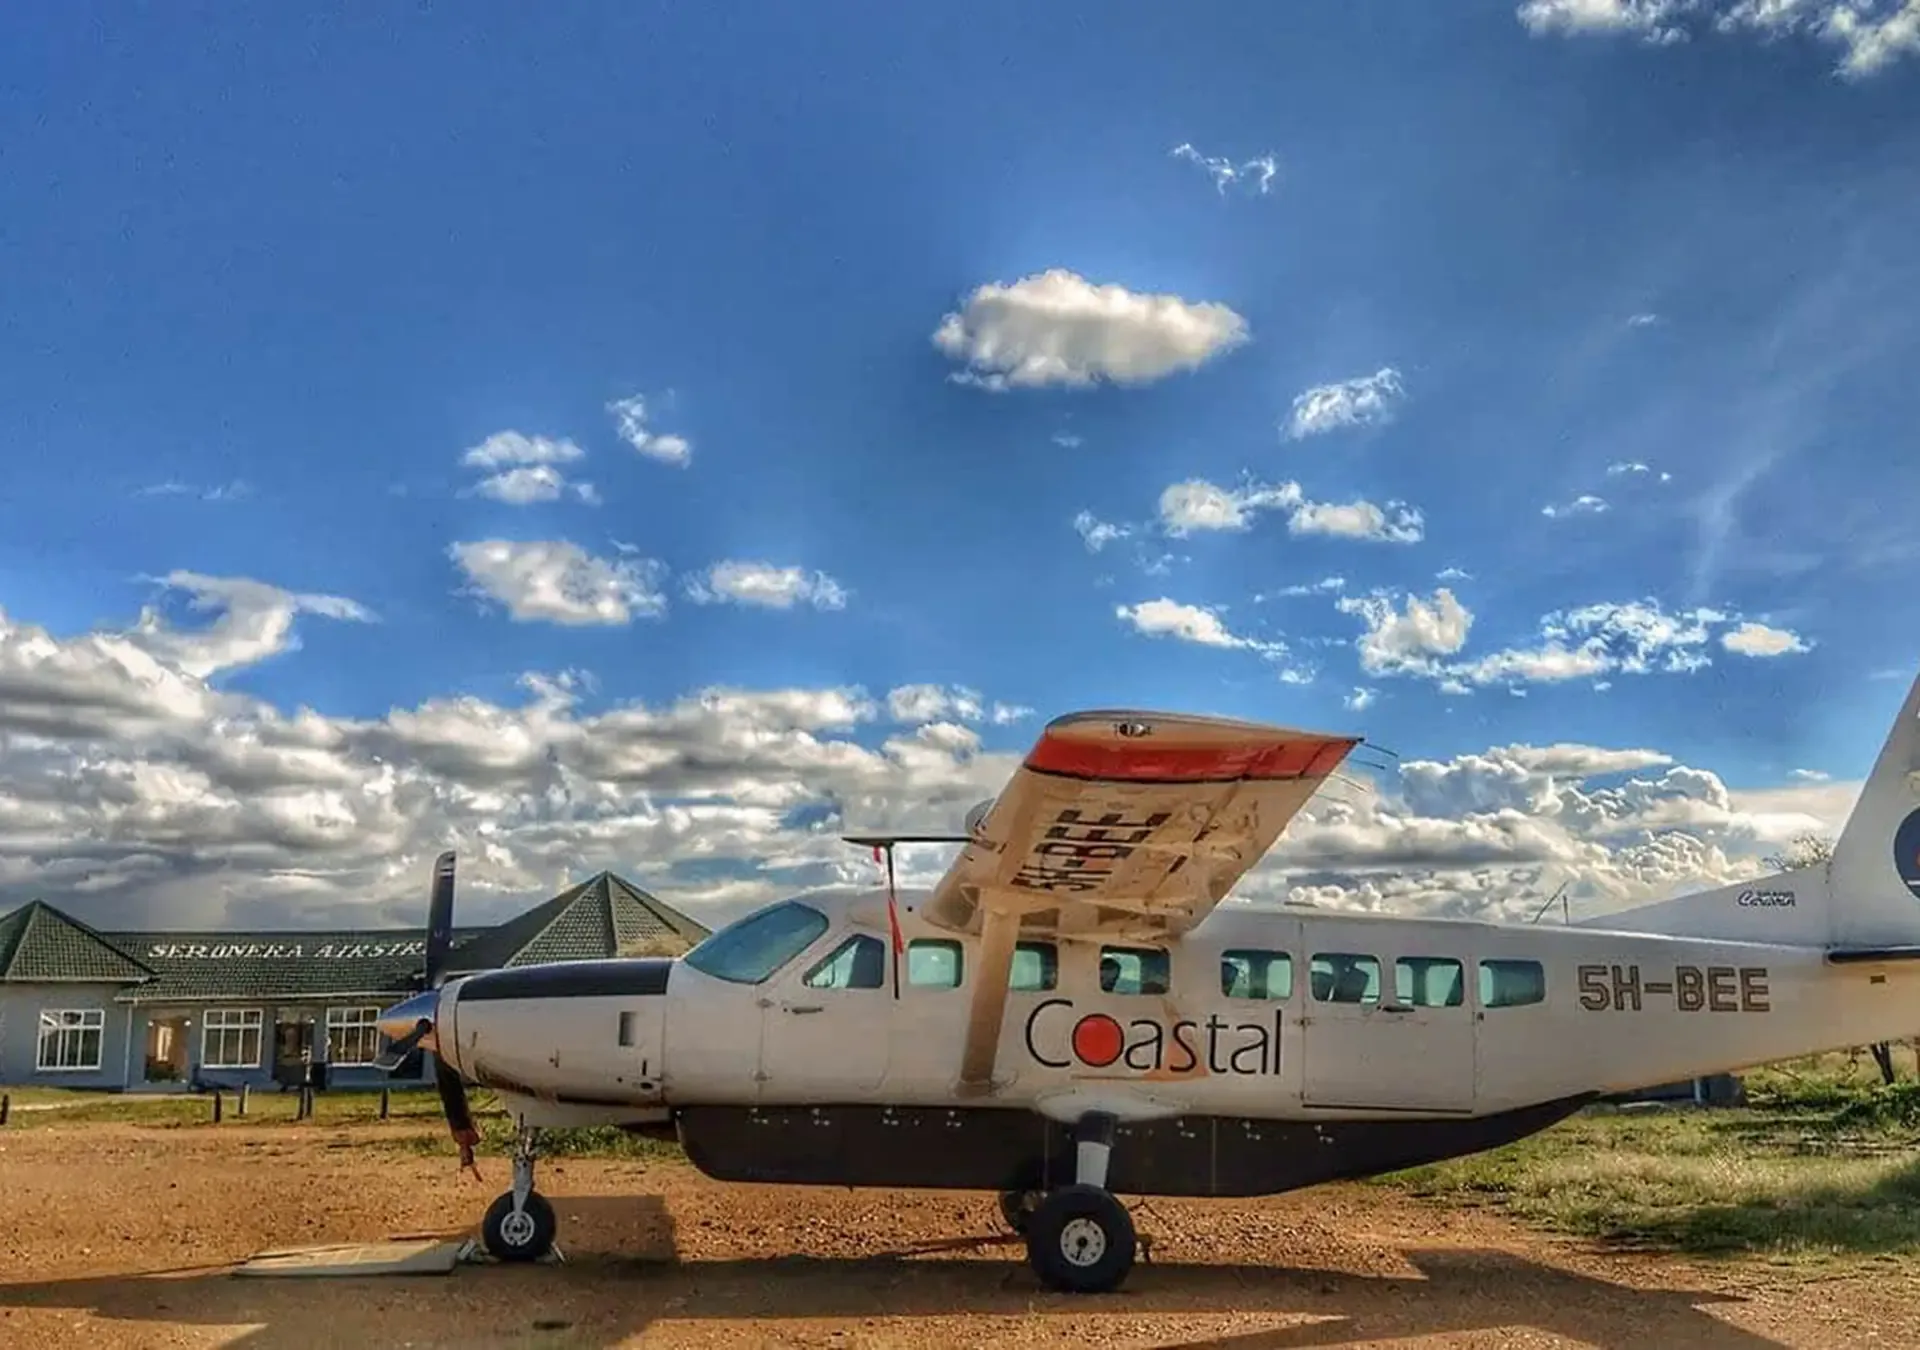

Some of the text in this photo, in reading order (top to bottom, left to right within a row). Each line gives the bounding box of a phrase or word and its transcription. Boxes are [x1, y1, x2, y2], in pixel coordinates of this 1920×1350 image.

[1010, 809, 1173, 892] 5H-BEE
[148, 943, 303, 959] SERONERA
[1578, 965, 1770, 1012] 5H-BEE
[1025, 999, 1282, 1075] Coastal
